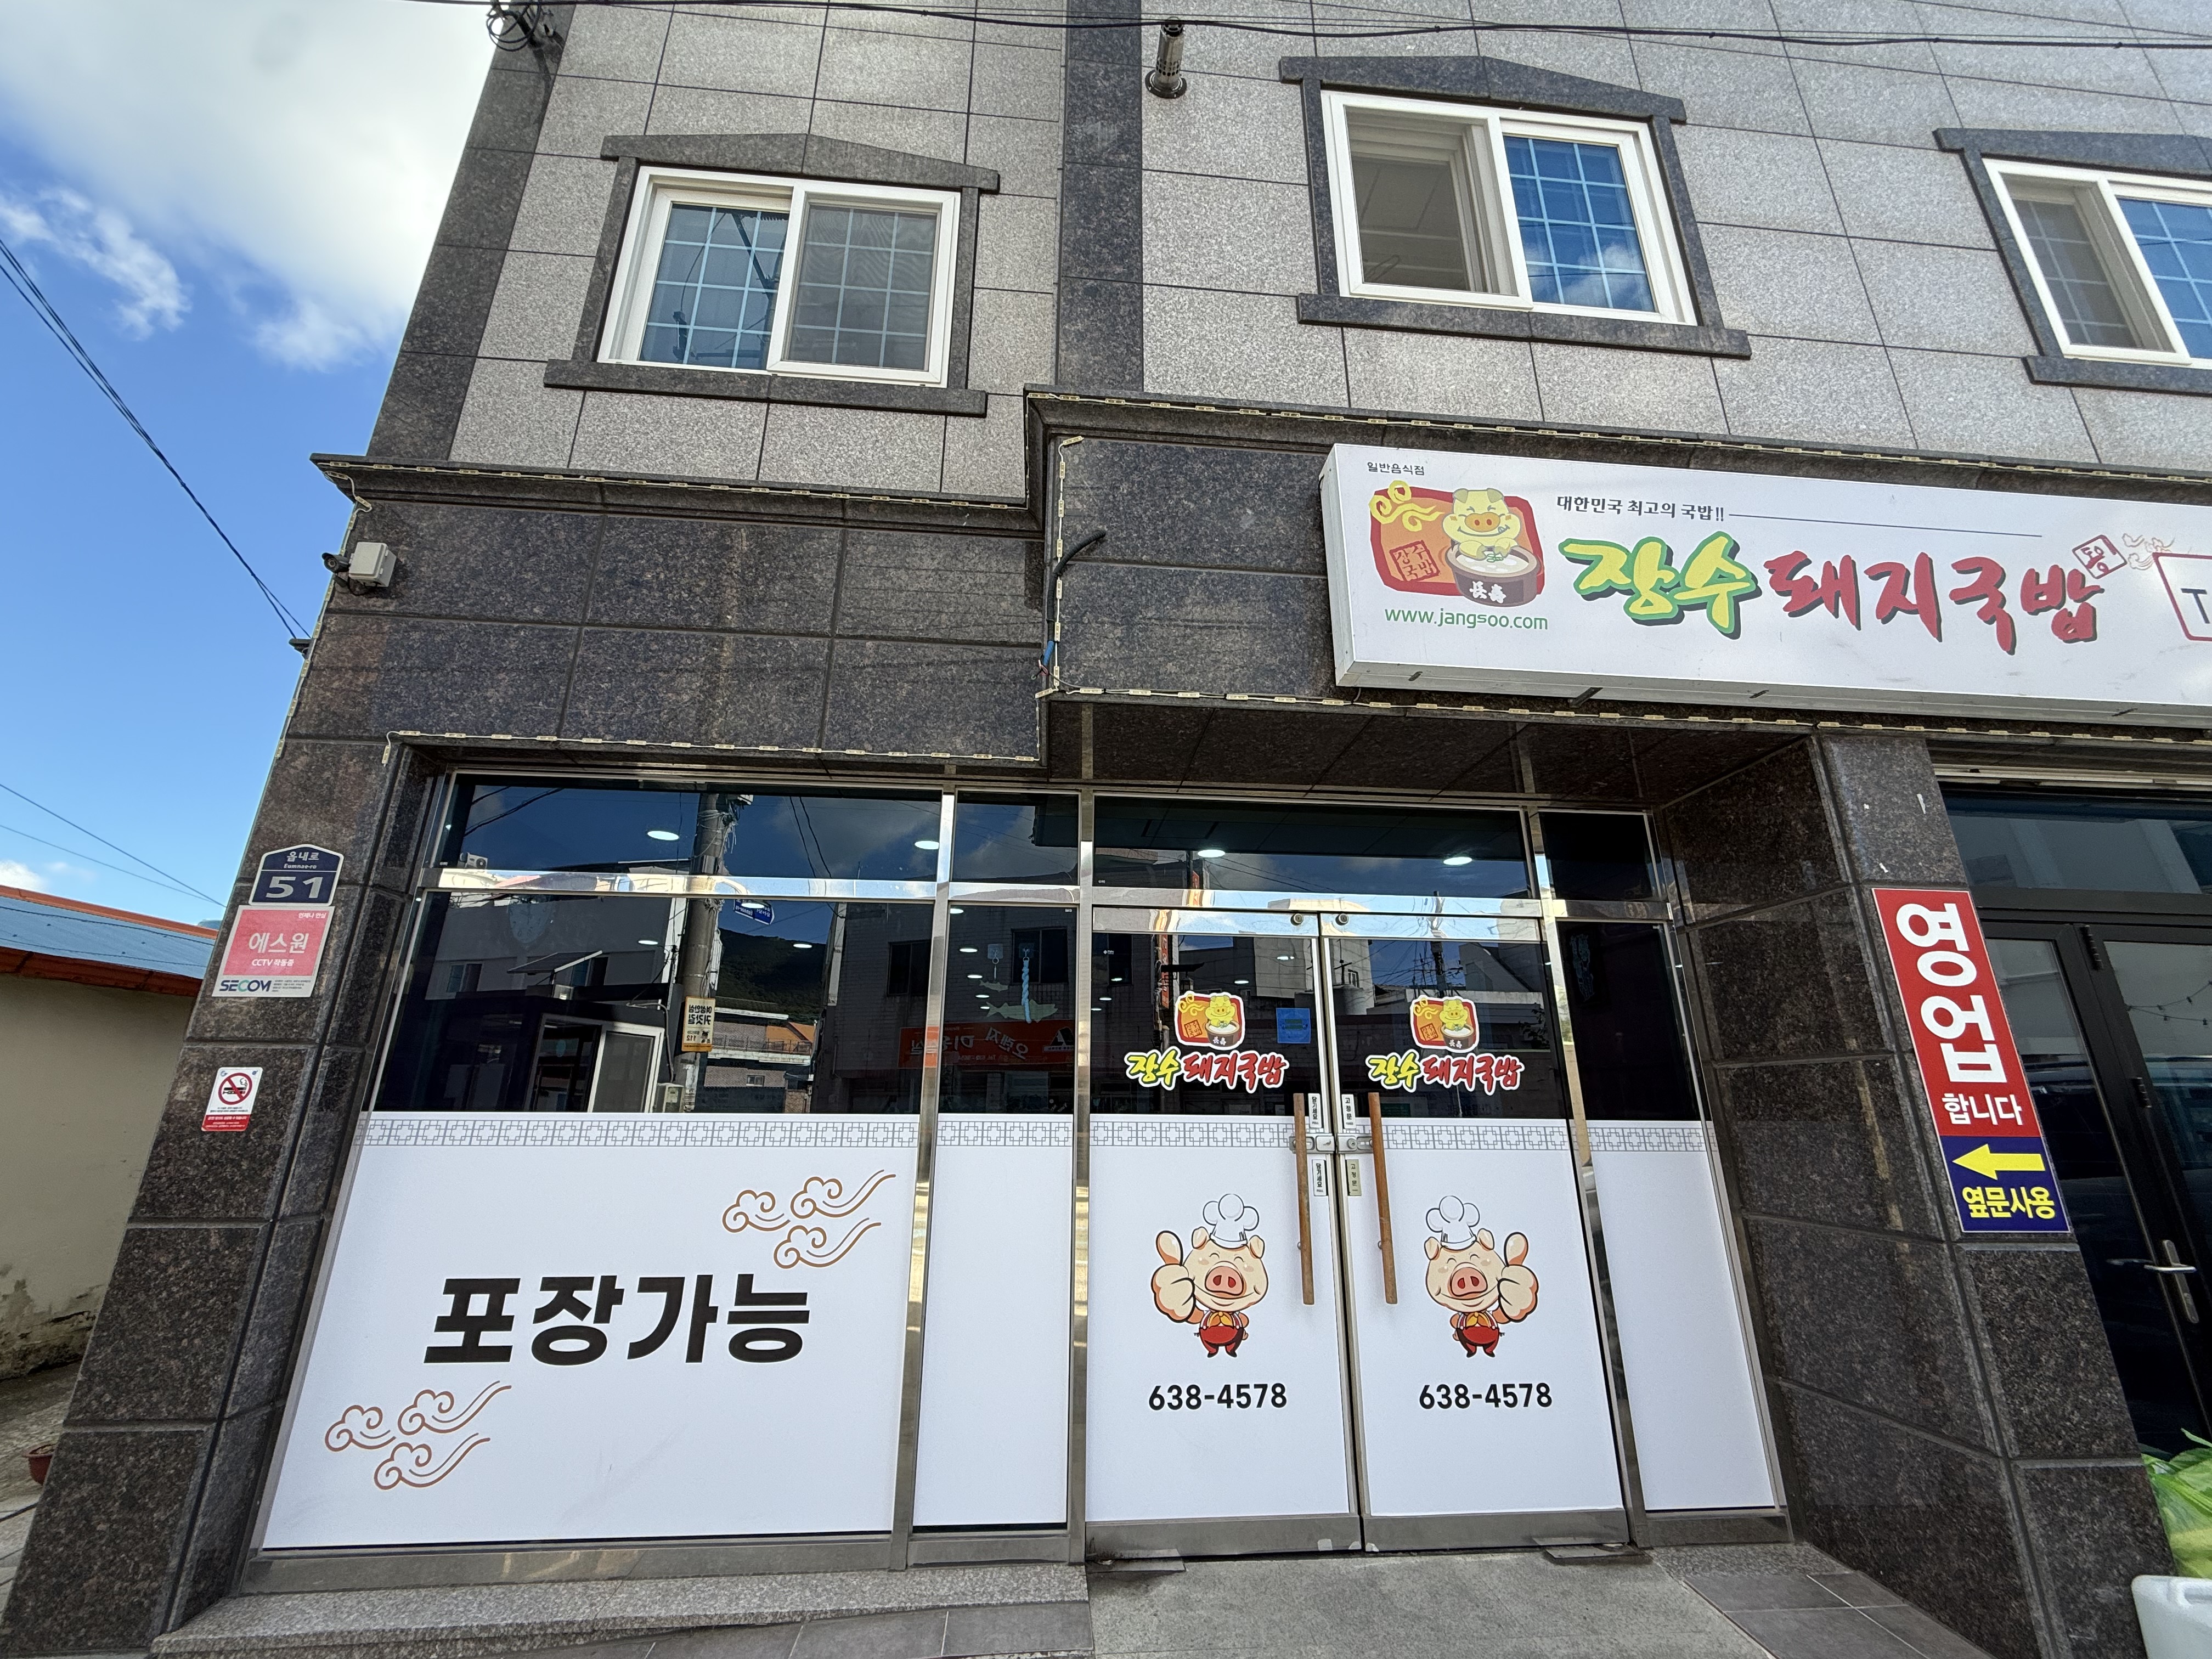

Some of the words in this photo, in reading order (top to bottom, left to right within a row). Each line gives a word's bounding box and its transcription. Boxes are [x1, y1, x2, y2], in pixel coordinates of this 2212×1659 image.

[1367, 461, 1425, 476] 일반음식점
[1556, 495, 1622, 515] 대한민국
[1627, 499, 1676, 518] 최고의
[1680, 504, 1725, 522] 국밥!!
[1384, 608, 1548, 630] www.jangsoo.com
[286, 851, 320, 862] 읍내로
[265, 876, 324, 899] 51
[249, 933, 309, 953] 에스원
[252, 958, 273, 967] CCTV
[219, 979, 272, 992] SECOM
[1895, 902, 2008, 1083] 영업
[1942, 1093, 2023, 1126] 합니다
[1961, 1186, 2056, 1220] 옆문사용
[423, 1273, 811, 1366] 포장가능
[1148, 1383, 1288, 1412] 638-4578
[1418, 1382, 1553, 1409] 638-4578
